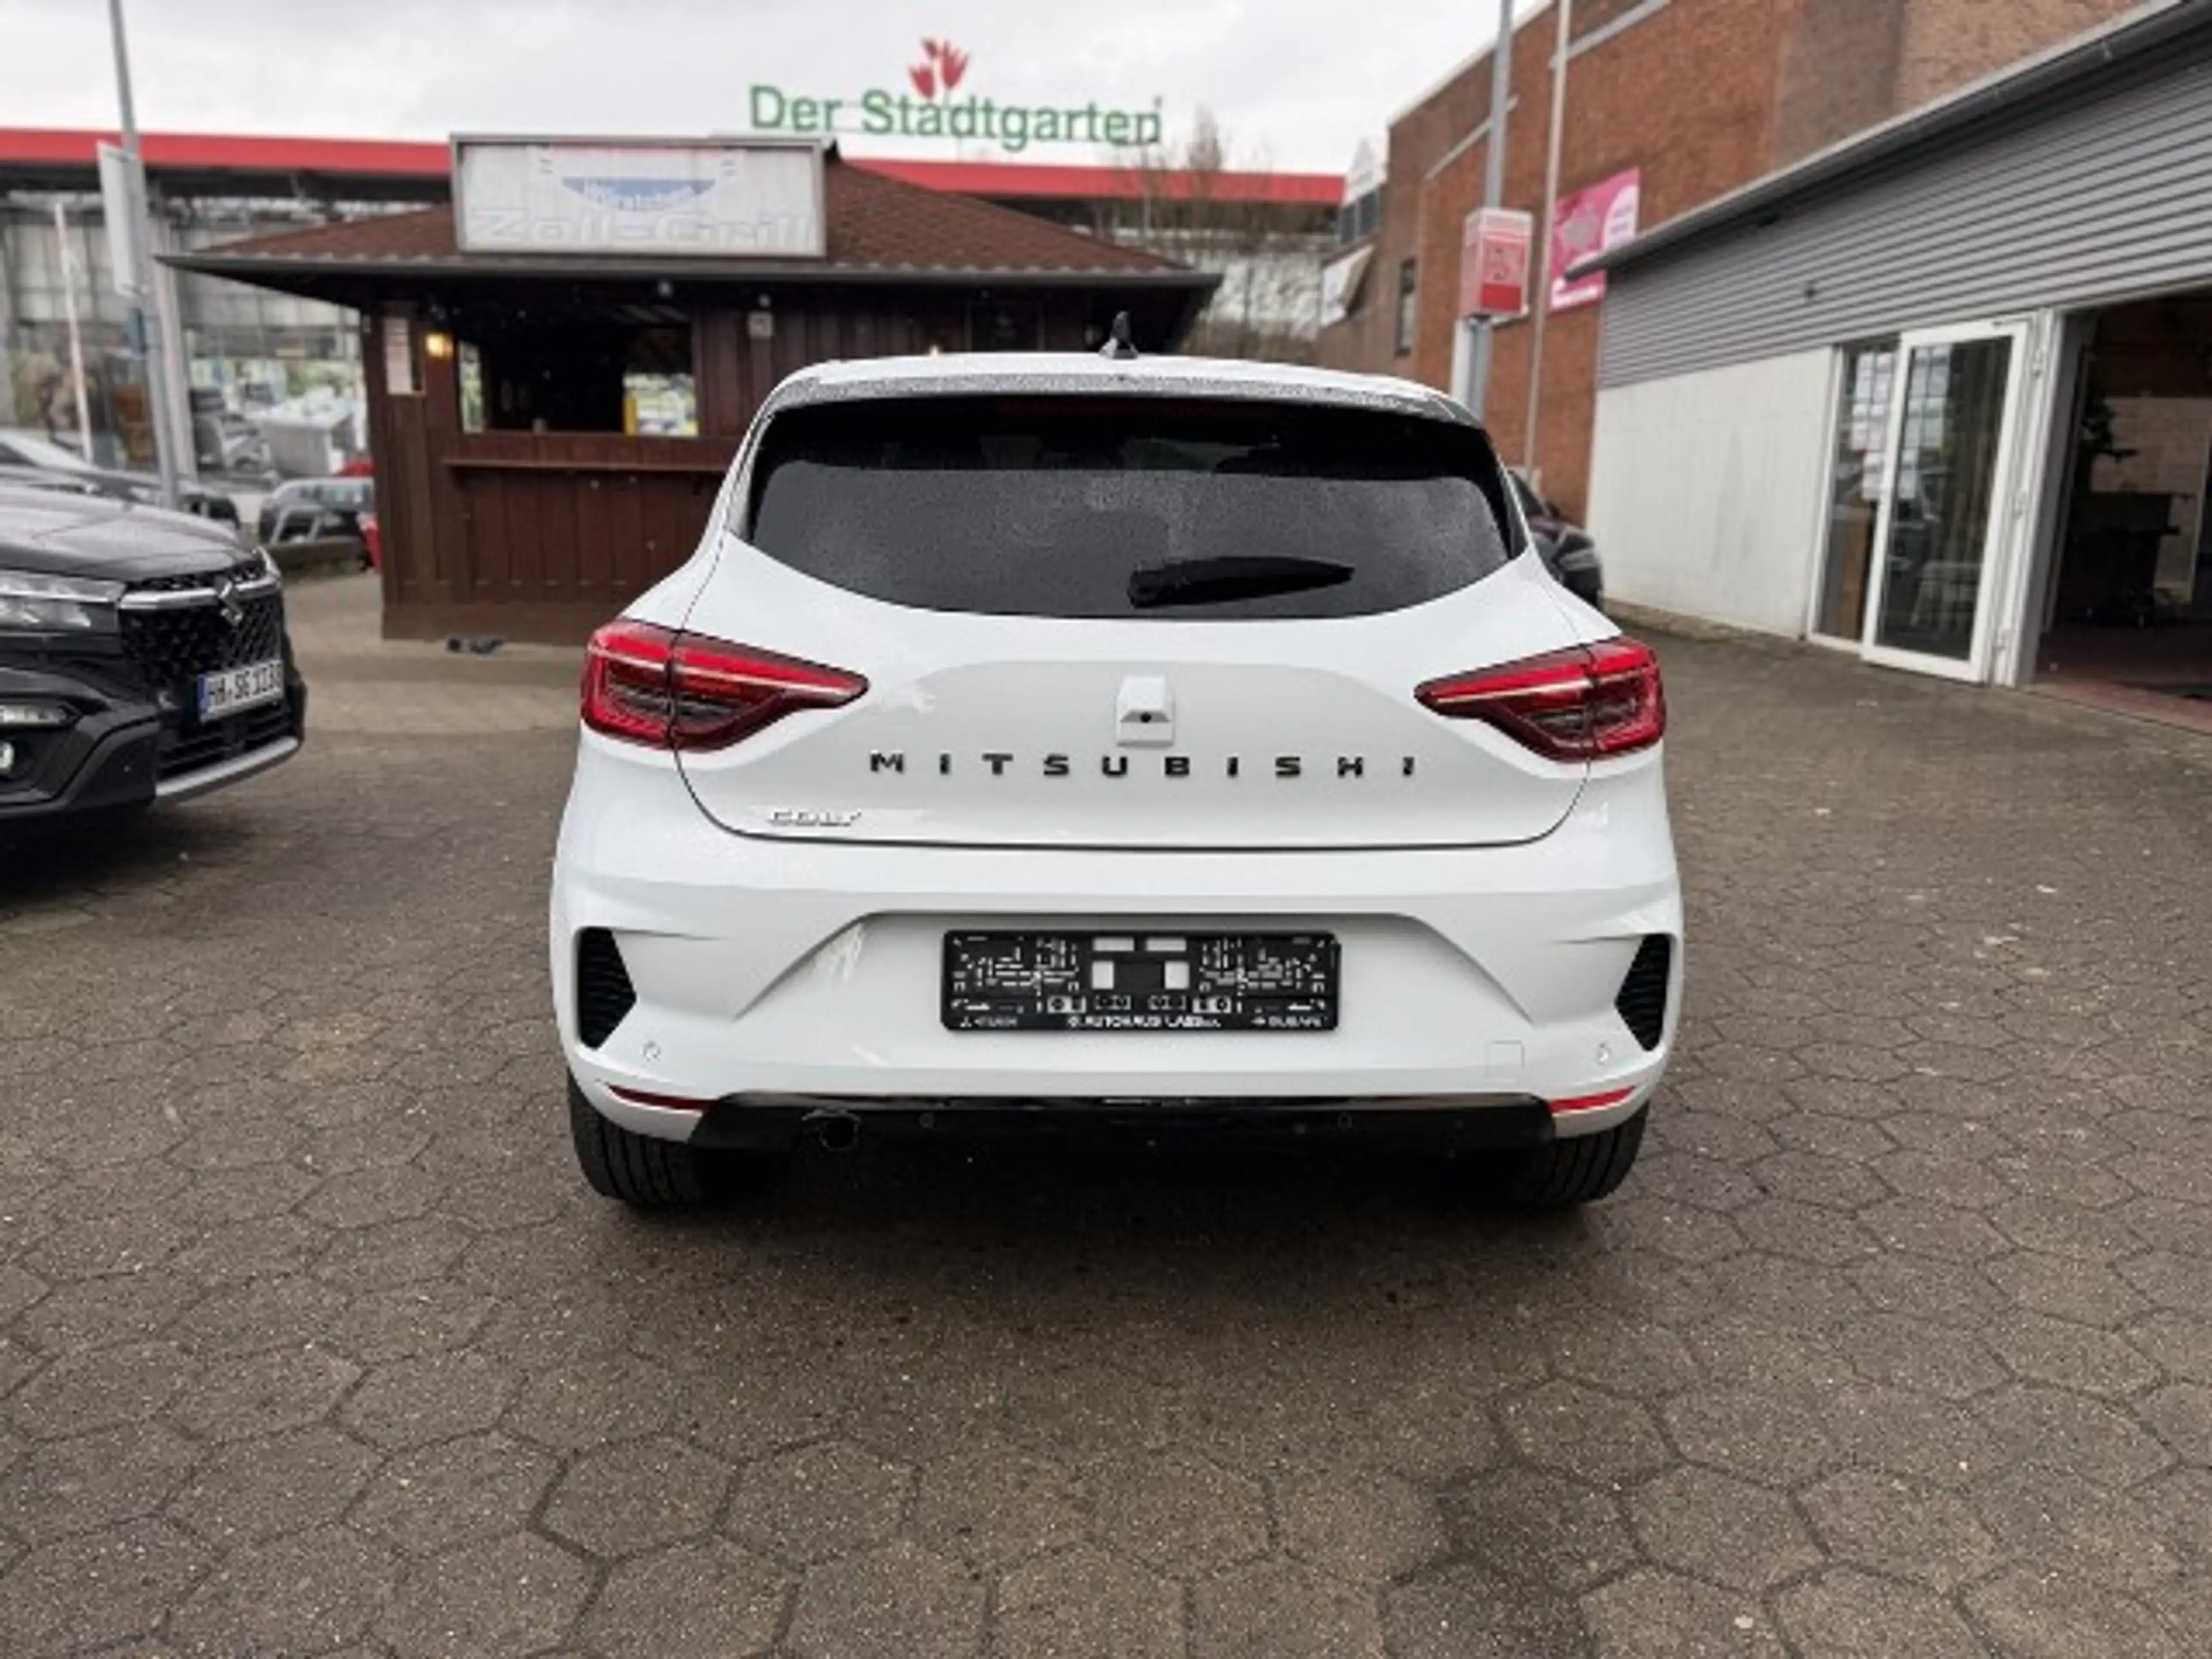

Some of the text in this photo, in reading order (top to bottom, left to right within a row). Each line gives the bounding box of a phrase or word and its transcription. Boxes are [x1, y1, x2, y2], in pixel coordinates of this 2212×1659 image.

[750, 85, 1162, 152] Der Stadtgarten
[869, 749, 1415, 778] MITSUBISHI
